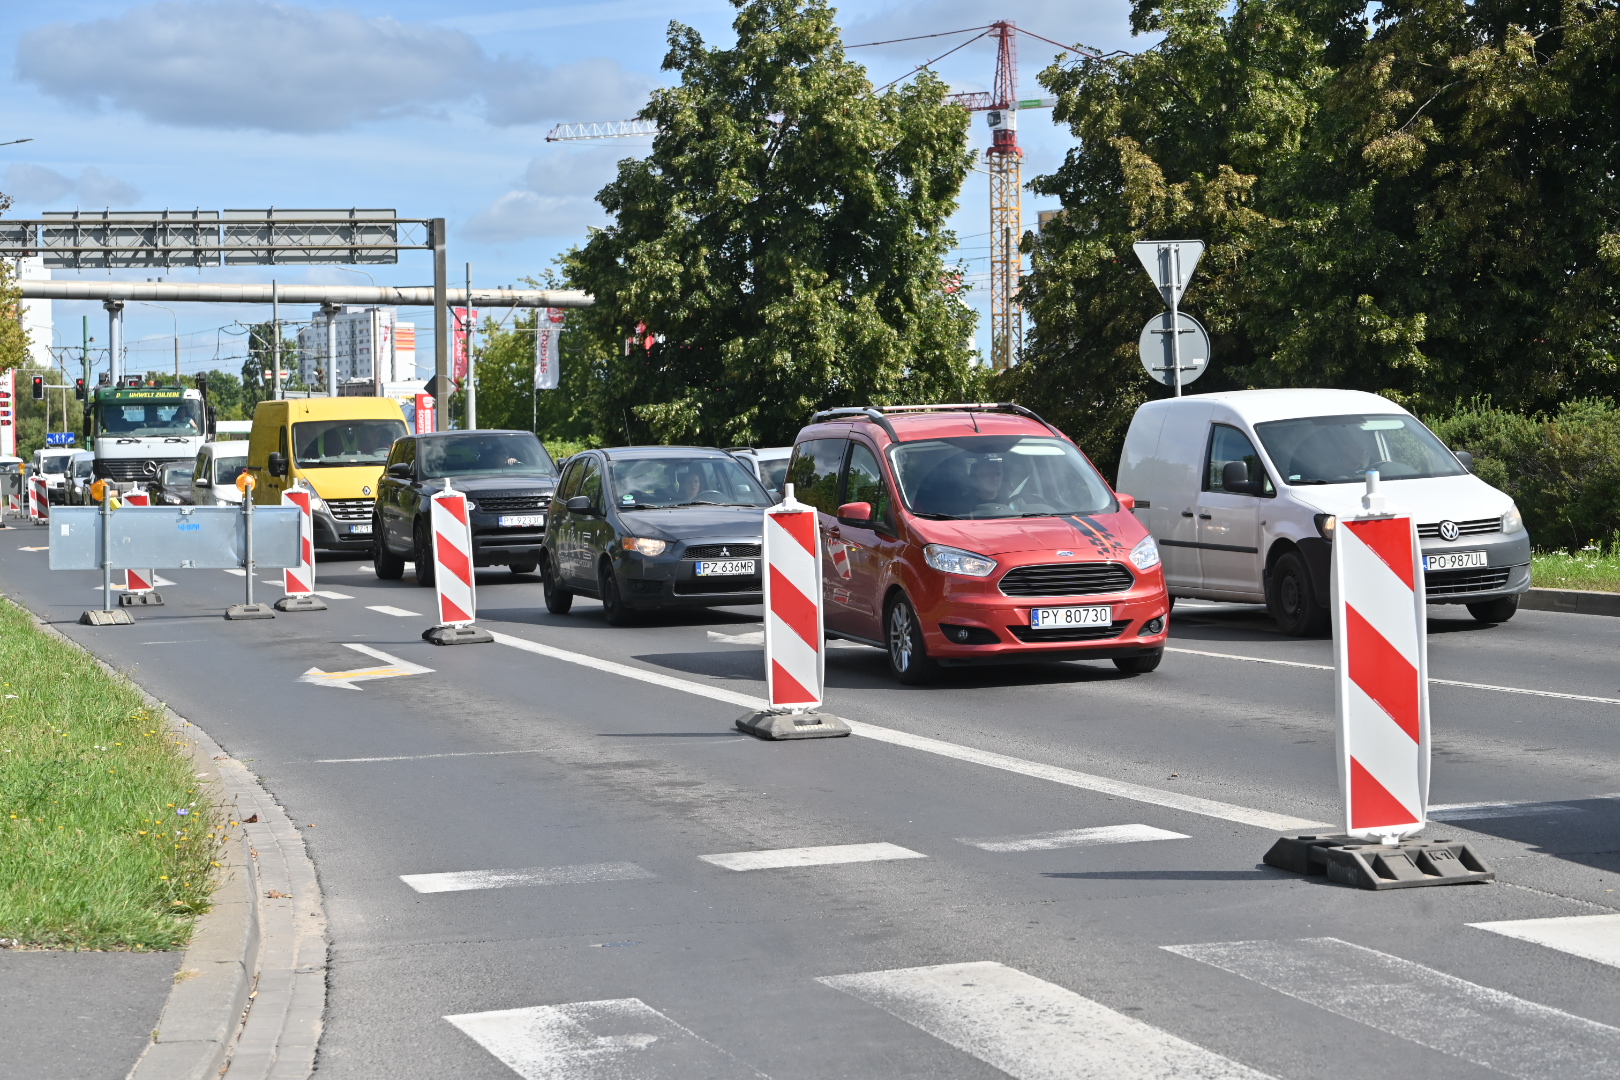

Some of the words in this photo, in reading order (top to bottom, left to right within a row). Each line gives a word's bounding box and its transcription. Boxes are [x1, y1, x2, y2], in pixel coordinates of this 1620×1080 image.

[541, 328, 550, 374] SELGROS
[702, 562, 718, 573] PZ
[722, 562, 754, 572] 636MR
[1429, 556, 1447, 569] PO
[1450, 553, 1486, 568] 987UL
[1041, 610, 1059, 625] PY
[1065, 608, 1107, 623] 80730
